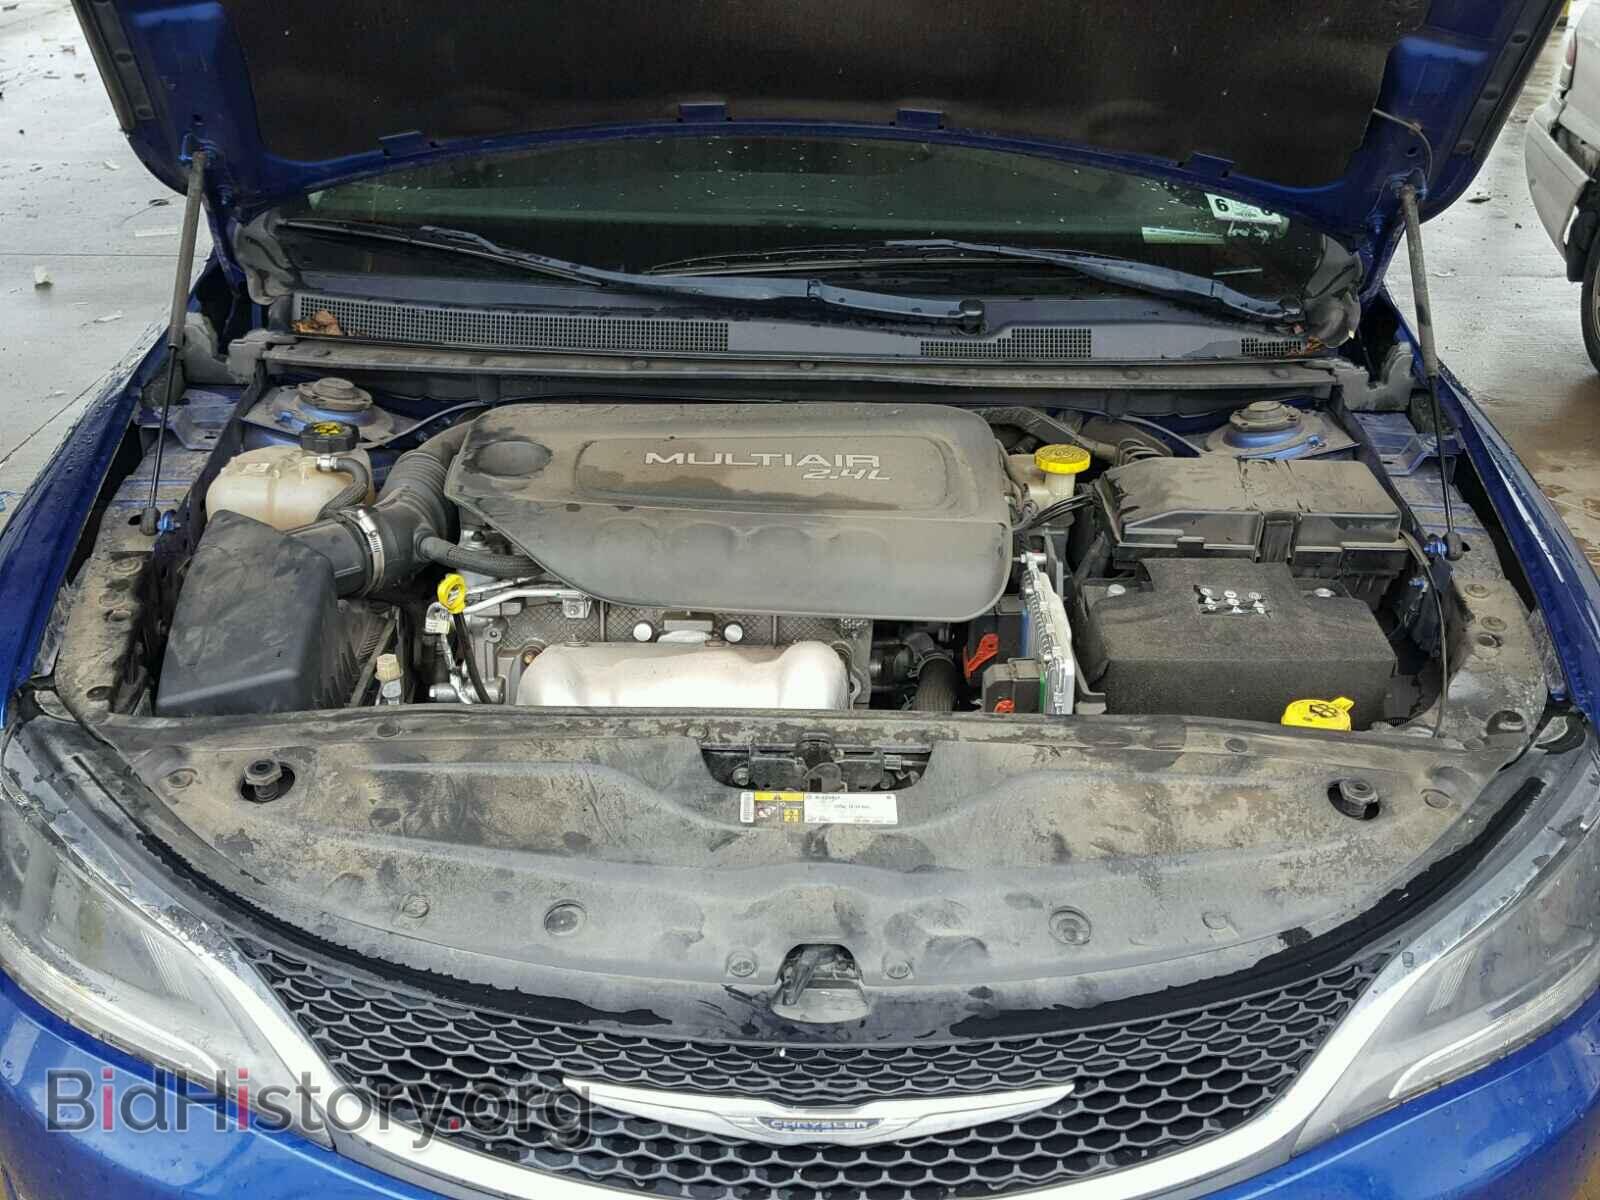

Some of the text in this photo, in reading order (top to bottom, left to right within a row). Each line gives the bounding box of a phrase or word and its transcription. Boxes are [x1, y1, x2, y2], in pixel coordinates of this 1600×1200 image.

[1215, 198, 1229, 212] 6
[645, 453, 880, 467] MULTIAIR
[802, 468, 890, 480] 2.4L
[769, 1119, 869, 1130] CHRYSLER
